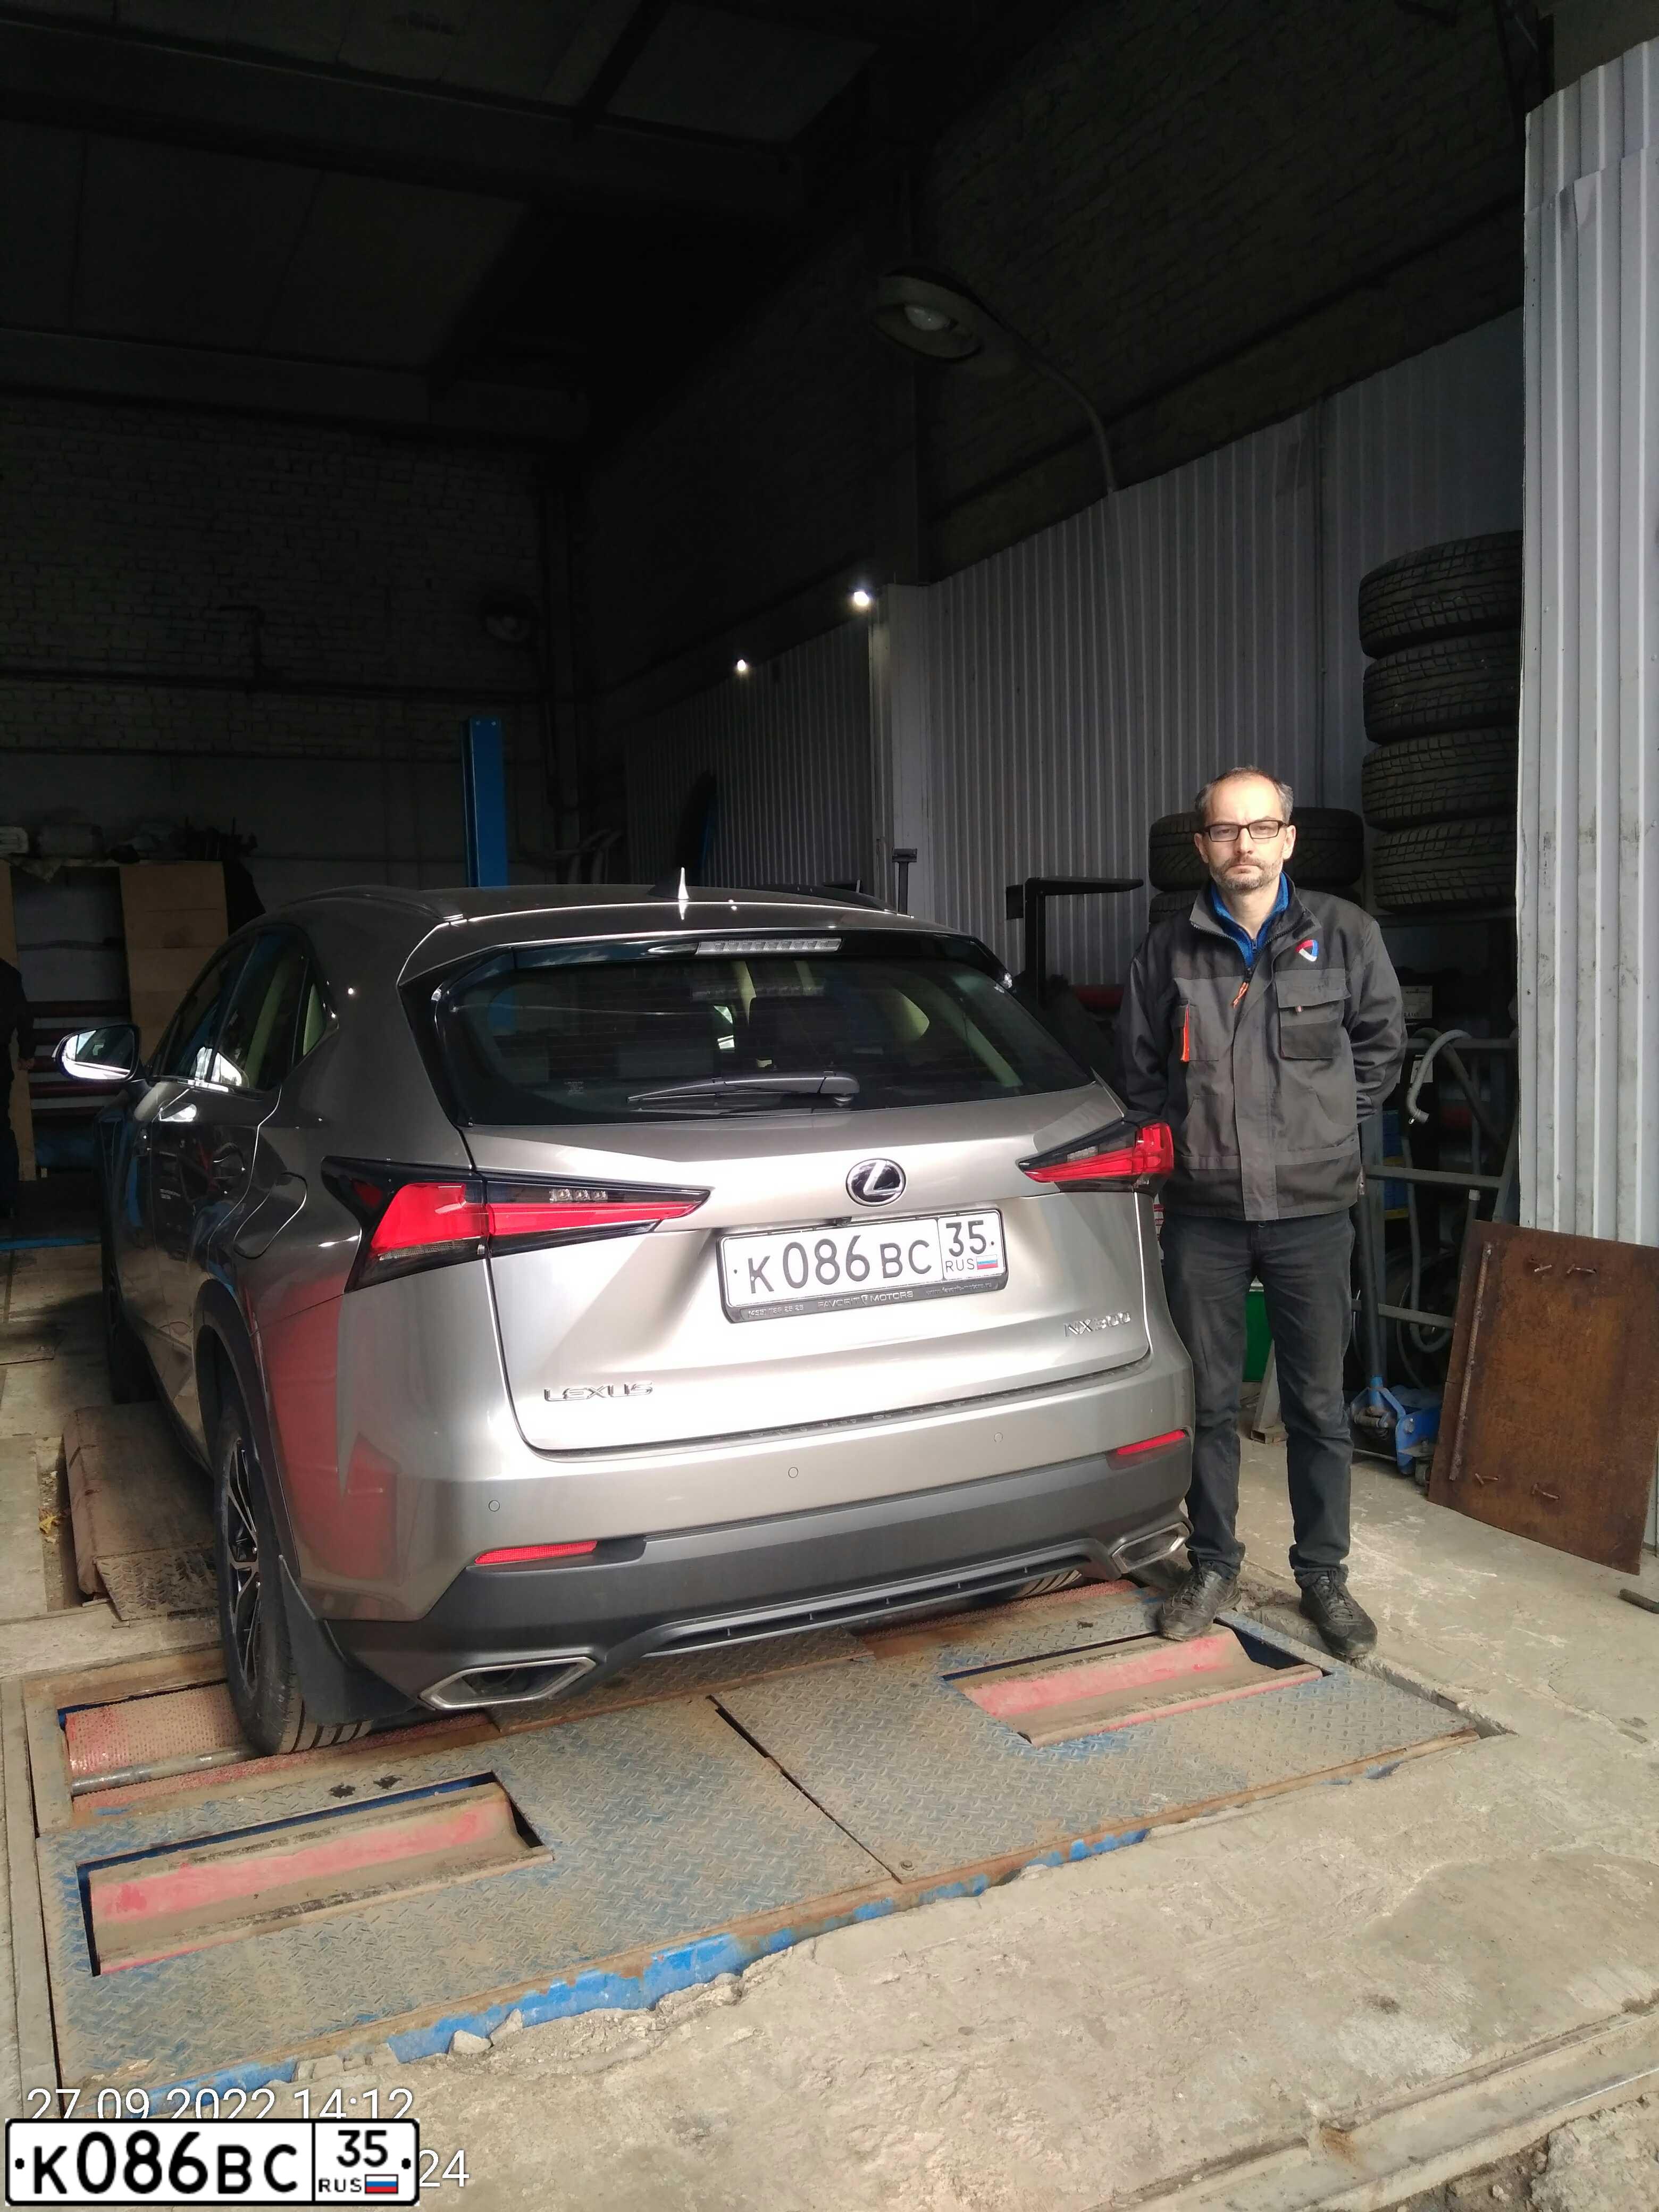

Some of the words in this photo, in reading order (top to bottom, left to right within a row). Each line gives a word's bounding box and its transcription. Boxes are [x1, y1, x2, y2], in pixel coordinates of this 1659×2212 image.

[945, 1220, 987, 1257] 35
[945, 1258, 975, 1272] RUS
[817, 1297, 860, 1308] FAVORIT
[870, 1291, 914, 1302] MOTORS
[543, 1382, 653, 1402] LEXUS
